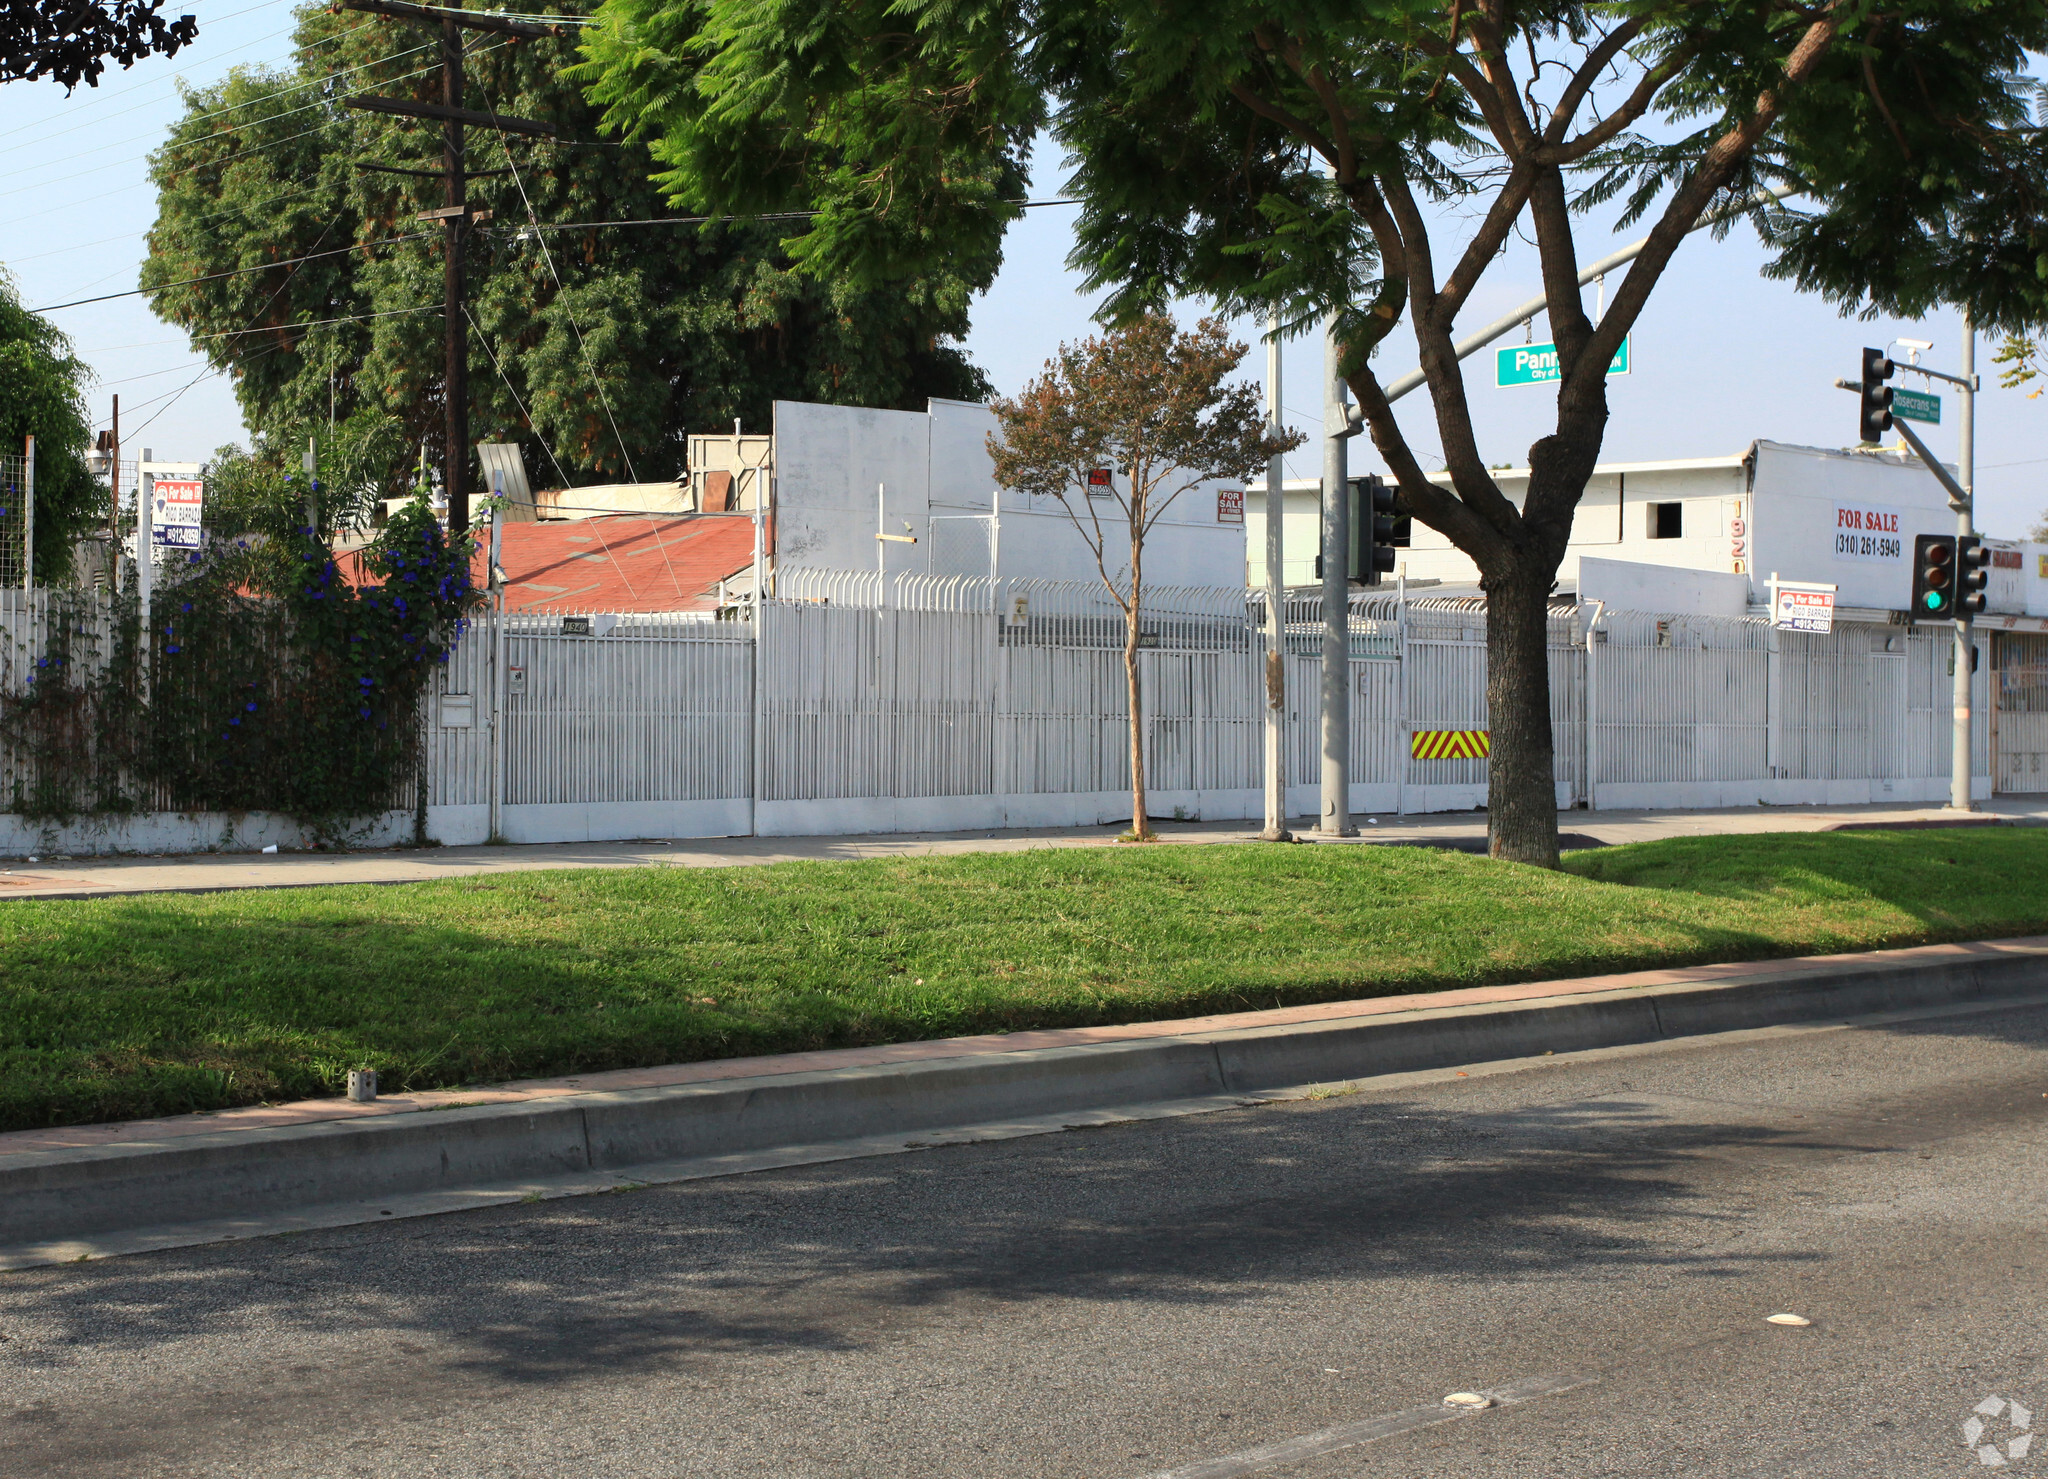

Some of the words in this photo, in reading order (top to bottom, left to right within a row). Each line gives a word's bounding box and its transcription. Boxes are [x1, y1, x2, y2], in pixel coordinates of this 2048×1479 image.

[1531, 370, 1546, 379] City
[1547, 368, 1556, 376] of
[1893, 391, 1930, 411] Rosecrans
[168, 486, 179, 500] For
[180, 486, 193, 500] Sale
[1222, 492, 1240, 500] FOR
[1219, 499, 1243, 509] SALE
[1837, 509, 1862, 530] FOR
[1865, 512, 1899, 533] SALE
[172, 527, 199, 544] 912-0359
[1835, 533, 1858, 556] (310)
[1860, 537, 1900, 558] 261-5949
[1796, 595, 1807, 604] For
[1808, 596, 1823, 605] Sale
[565, 622, 587, 632] 1940
[1799, 620, 1829, 631] 912-0359
